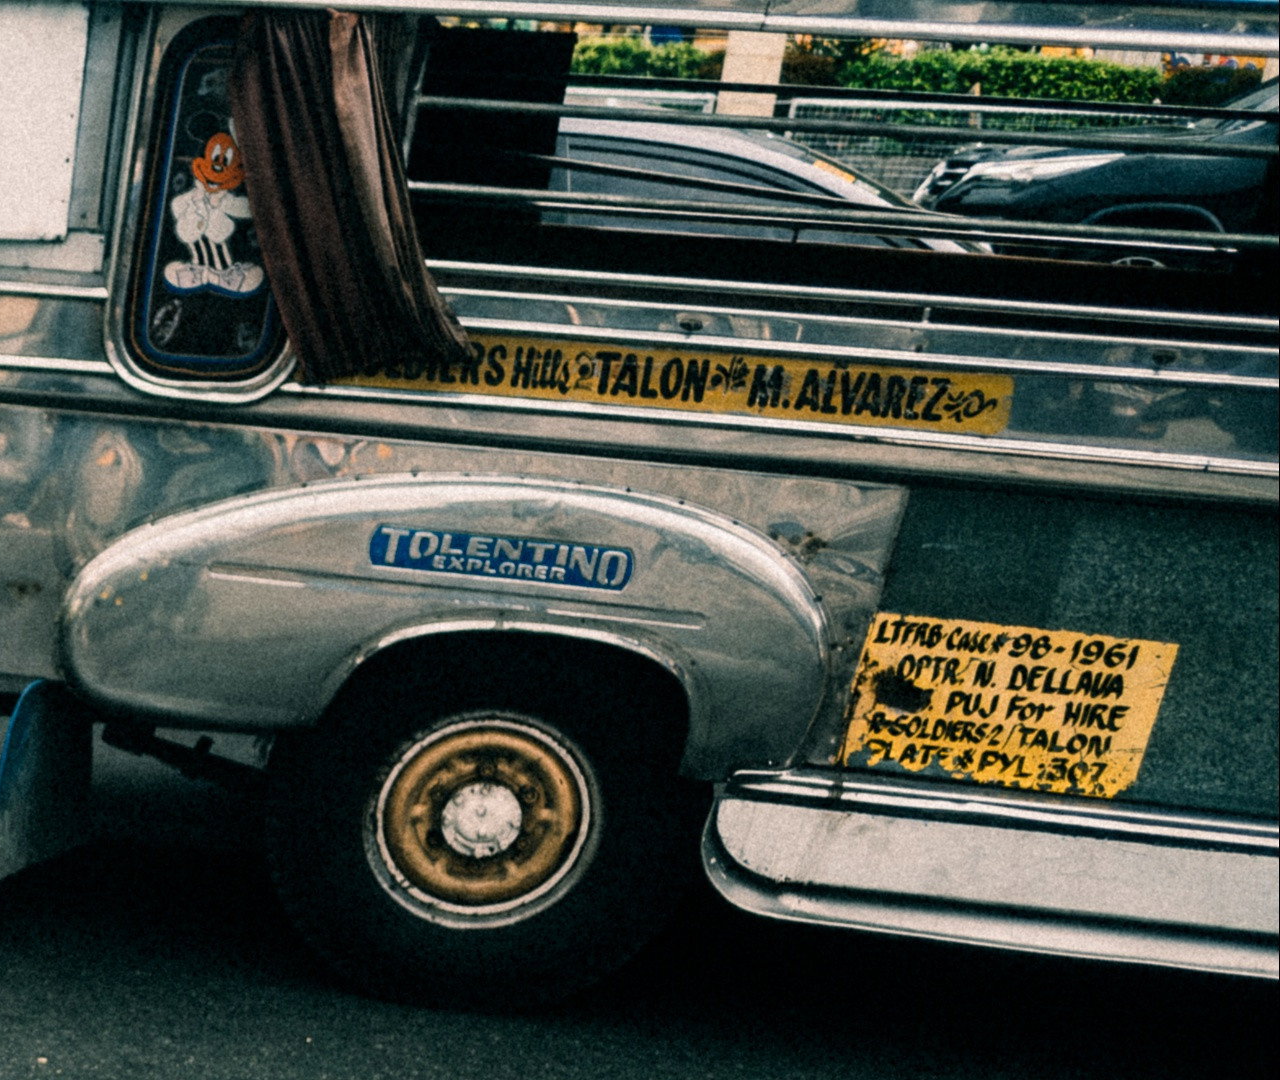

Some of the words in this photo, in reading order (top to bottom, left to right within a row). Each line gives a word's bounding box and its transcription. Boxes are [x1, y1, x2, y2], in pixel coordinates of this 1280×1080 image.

[511, 346, 570, 395] Hills
[595, 351, 710, 403] TALON
[747, 363, 791, 409] M.
[793, 366, 951, 421] ALVAREZ
[381, 527, 628, 587] TOLENTINO
[432, 555, 567, 581] EXPLORER
[1008, 633, 1140, 671] 98-1961
[944, 691, 1000, 719] PUJ
[1005, 695, 1055, 722] For
[1062, 701, 1130, 731] HIRE
